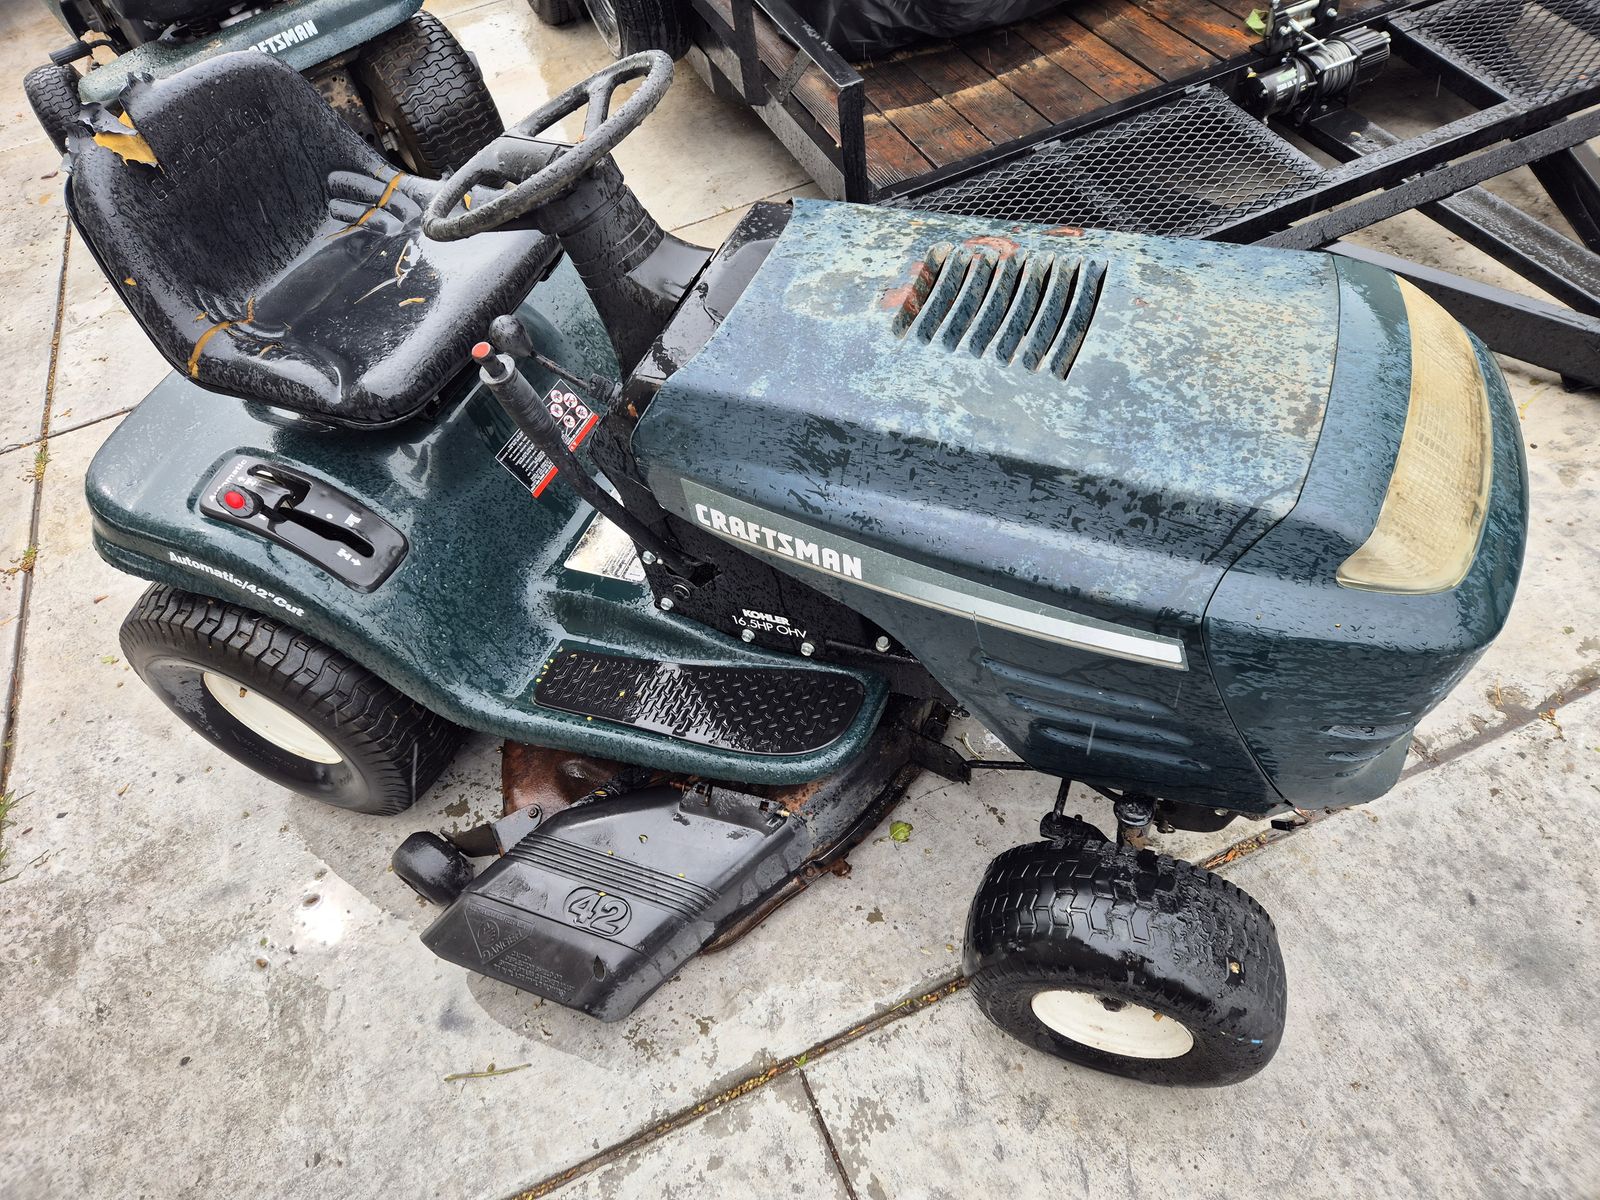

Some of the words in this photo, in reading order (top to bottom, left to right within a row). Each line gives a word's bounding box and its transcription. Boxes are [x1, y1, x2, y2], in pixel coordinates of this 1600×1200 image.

[249, 20, 318, 54] FTSMAN
[695, 503, 862, 579] CRAFTSMAN
[732, 615, 773, 631] 16.5HP
[776, 625, 806, 639] OHV
[742, 609, 790, 626] KOHLER
[568, 893, 627, 934] 42
